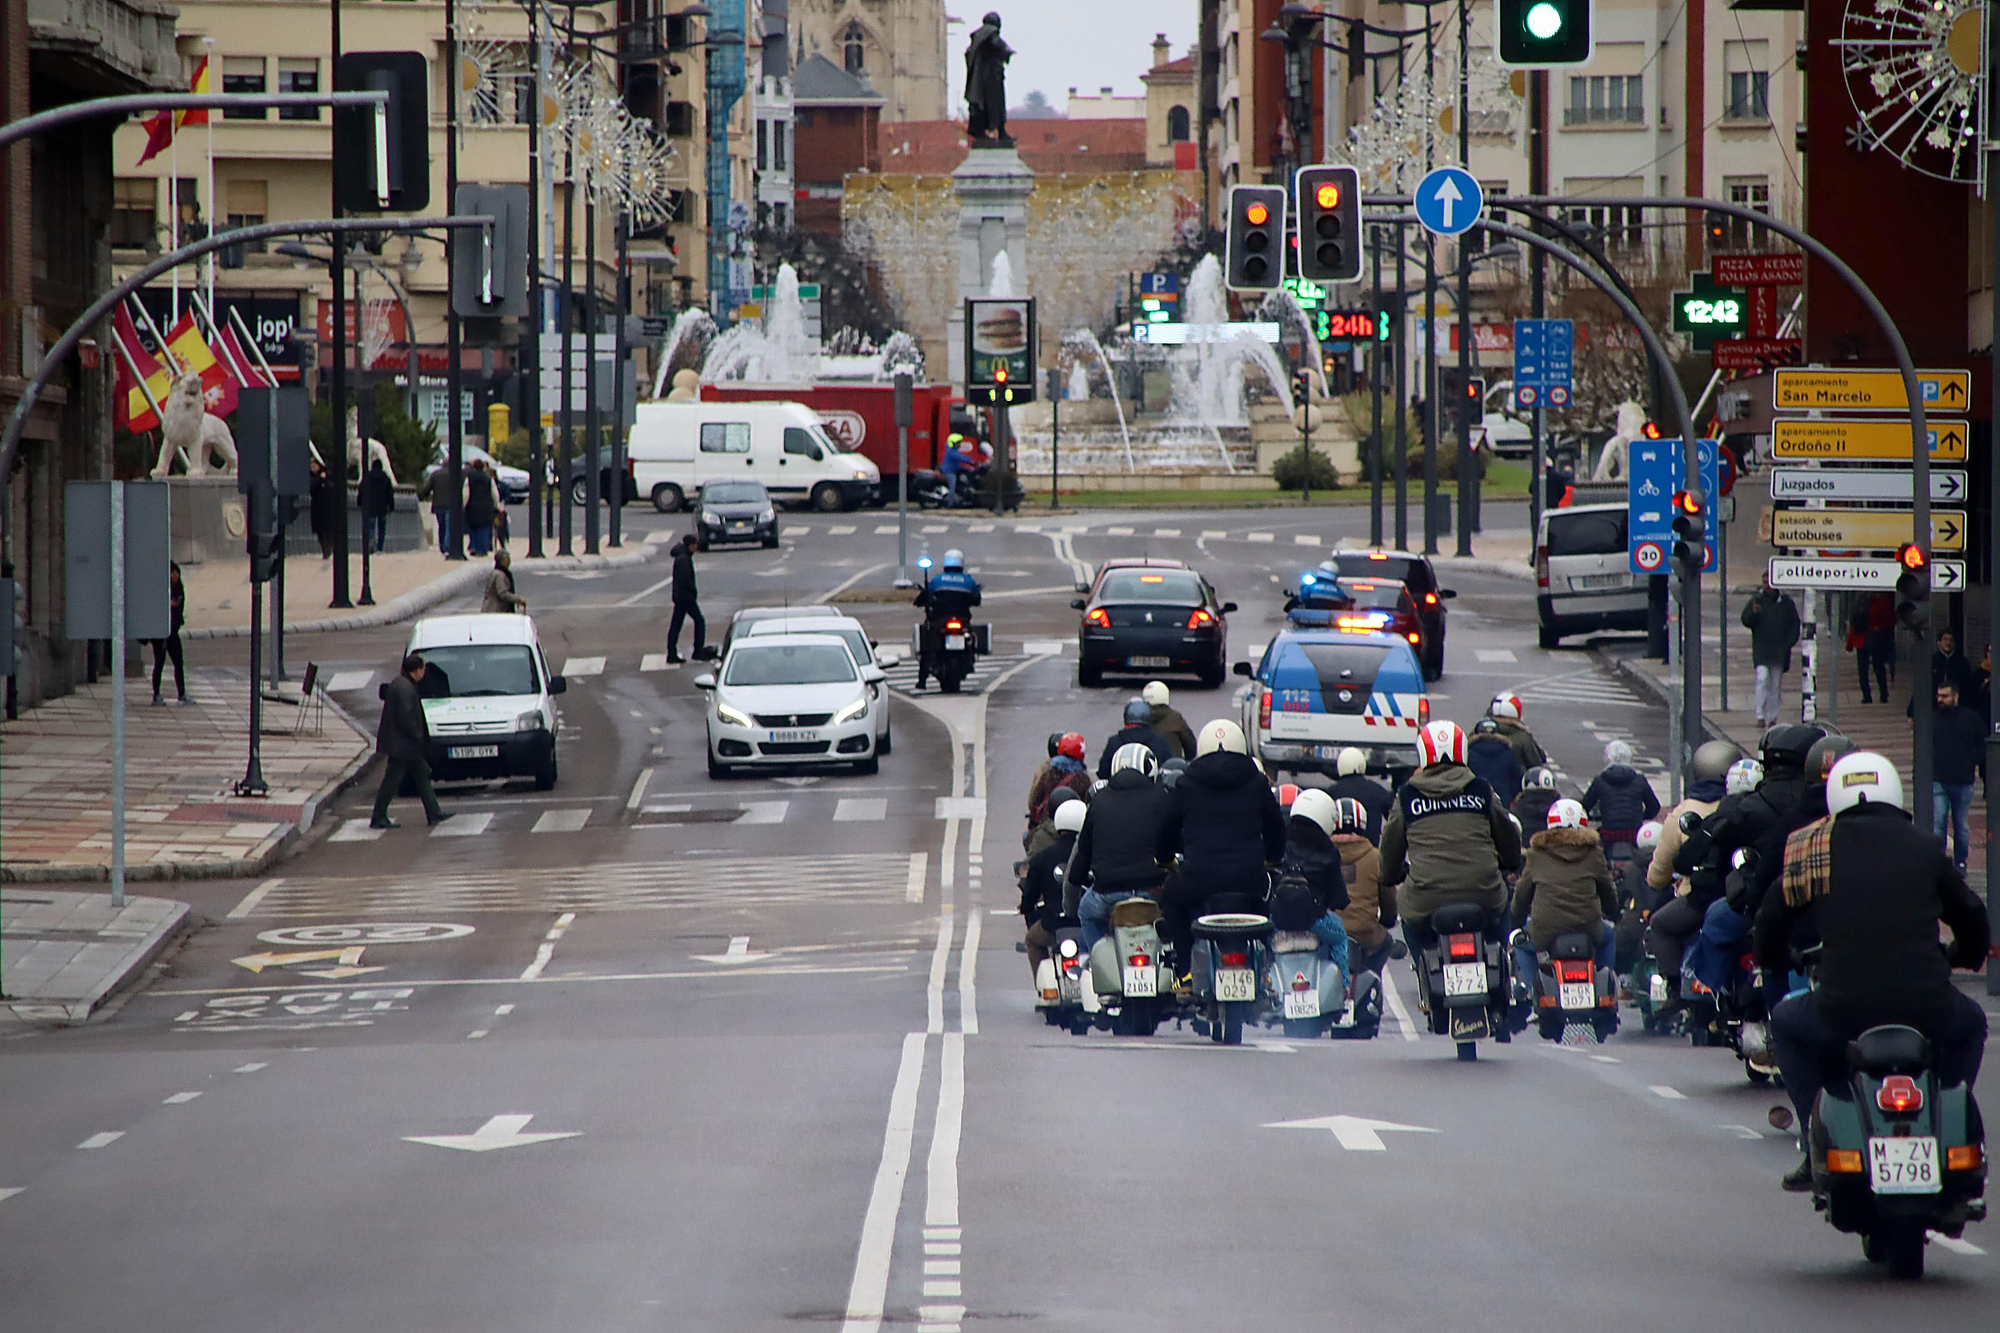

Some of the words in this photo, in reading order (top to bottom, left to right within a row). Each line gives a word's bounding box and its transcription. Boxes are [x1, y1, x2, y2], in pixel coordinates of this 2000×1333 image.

[1720, 259, 1753, 270] PIZZA
[1152, 273, 1166, 292] P
[1720, 272, 1758, 281] POLLOS
[1684, 300, 1740, 323] 12:42
[1331, 314, 1373, 336] 24h
[419, 375, 448, 386] Store
[1782, 378, 1849, 387] aparcamiento
[1783, 391, 1807, 402] San
[1816, 390, 1872, 402] Marcelo
[1922, 382, 1937, 399] P
[1781, 428, 1848, 437] aparcamiento
[1780, 440, 1831, 451] Ordoño
[1837, 441, 1846, 451] II
[1780, 478, 1835, 491] juzgados
[1779, 517, 1816, 525] estación
[1822, 516, 1834, 525] de
[1779, 530, 1842, 541] autobuses
[1641, 551, 1658, 561] 30
[1777, 566, 1879, 580] olideporivo
[1282, 689, 1310, 702] 112
[1282, 701, 1310, 713] 092
[1411, 795, 1483, 816] GUINNESS
[295, 925, 433, 939] 20
[1218, 974, 1253, 986] V-146
[1447, 979, 1485, 993] 3774
[1127, 981, 1155, 994] 21051
[1223, 985, 1248, 998] 029
[1563, 996, 1591, 1007] 3071
[1454, 1018, 1484, 1036] Vespa
[1879, 1163, 1932, 1182] 5798
